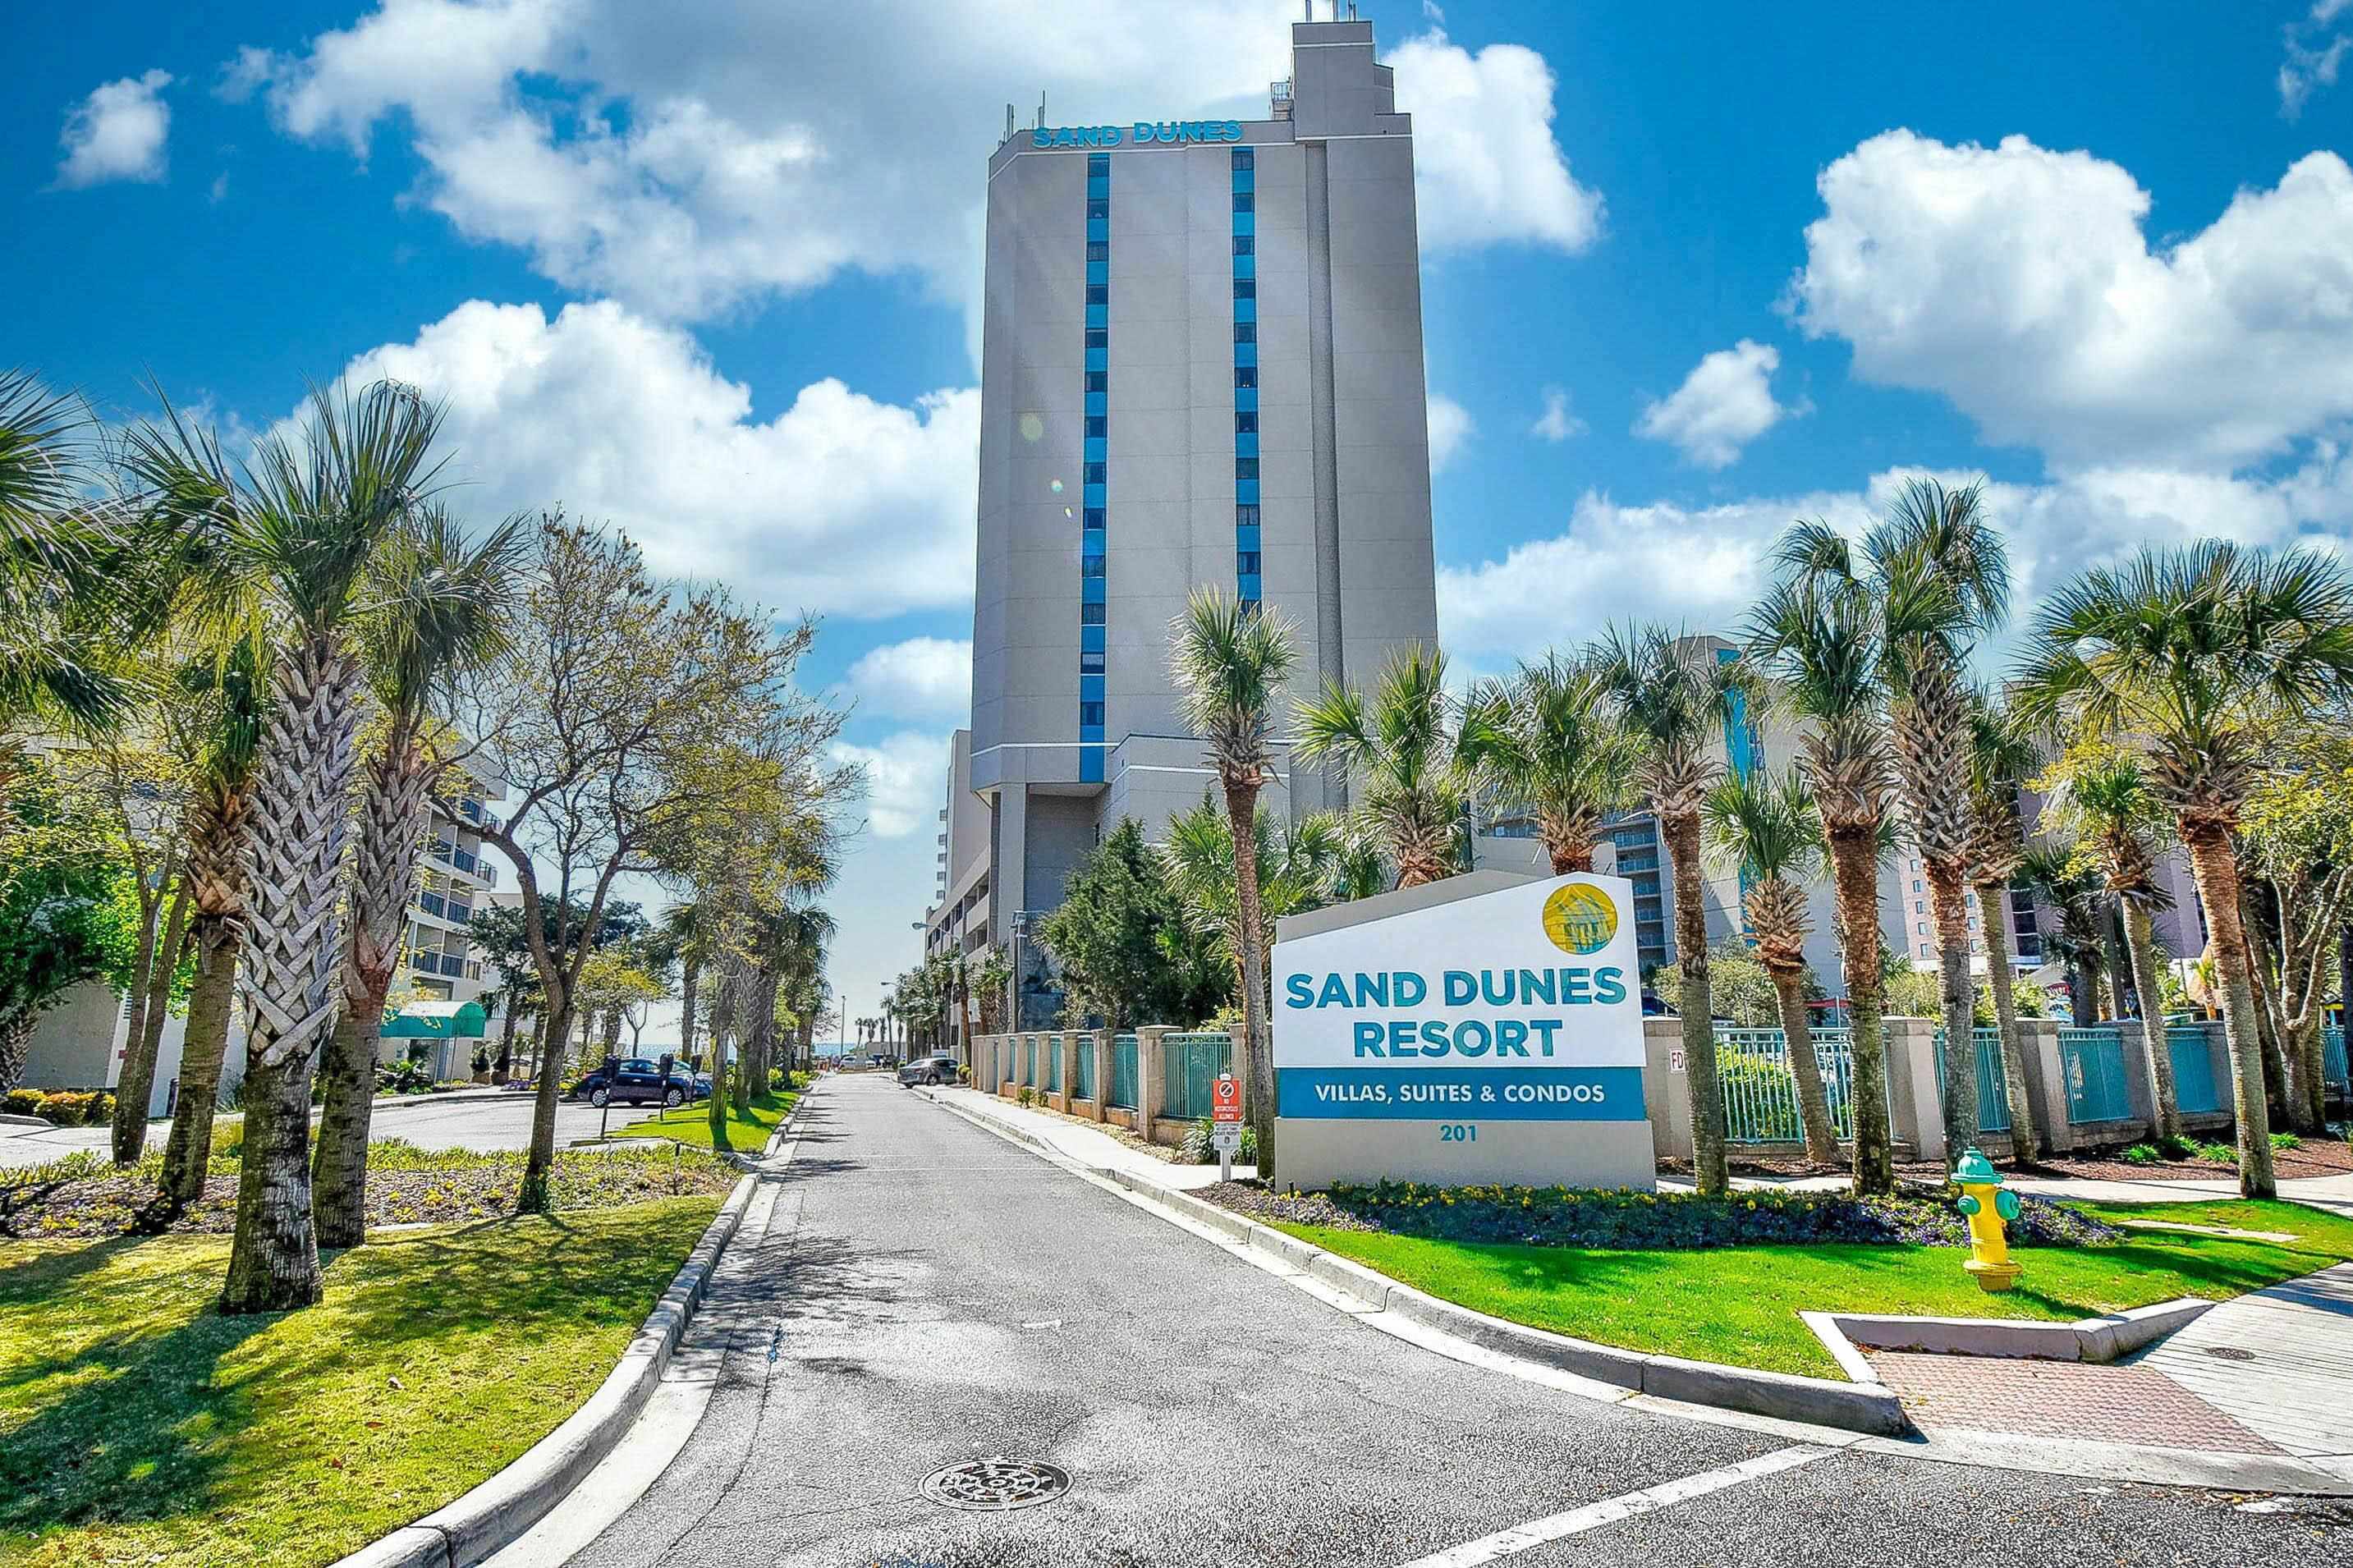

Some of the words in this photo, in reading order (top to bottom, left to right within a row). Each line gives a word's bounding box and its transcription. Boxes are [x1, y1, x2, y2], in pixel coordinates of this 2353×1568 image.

[1032, 126, 1122, 147] SAND
[1134, 121, 1244, 143] DUNES
[1286, 972, 1427, 1008] SAND
[1443, 967, 1626, 1006] DUNES
[1353, 1019, 1562, 1058] RESORT
[1672, 1052, 1684, 1069] FD
[1315, 1084, 1393, 1104] VILLAS,
[1399, 1084, 1472, 1103] SUITES
[1480, 1085, 1496, 1102] &
[1504, 1084, 1604, 1103] CONDOS
[1439, 1125, 1477, 1142] 201
